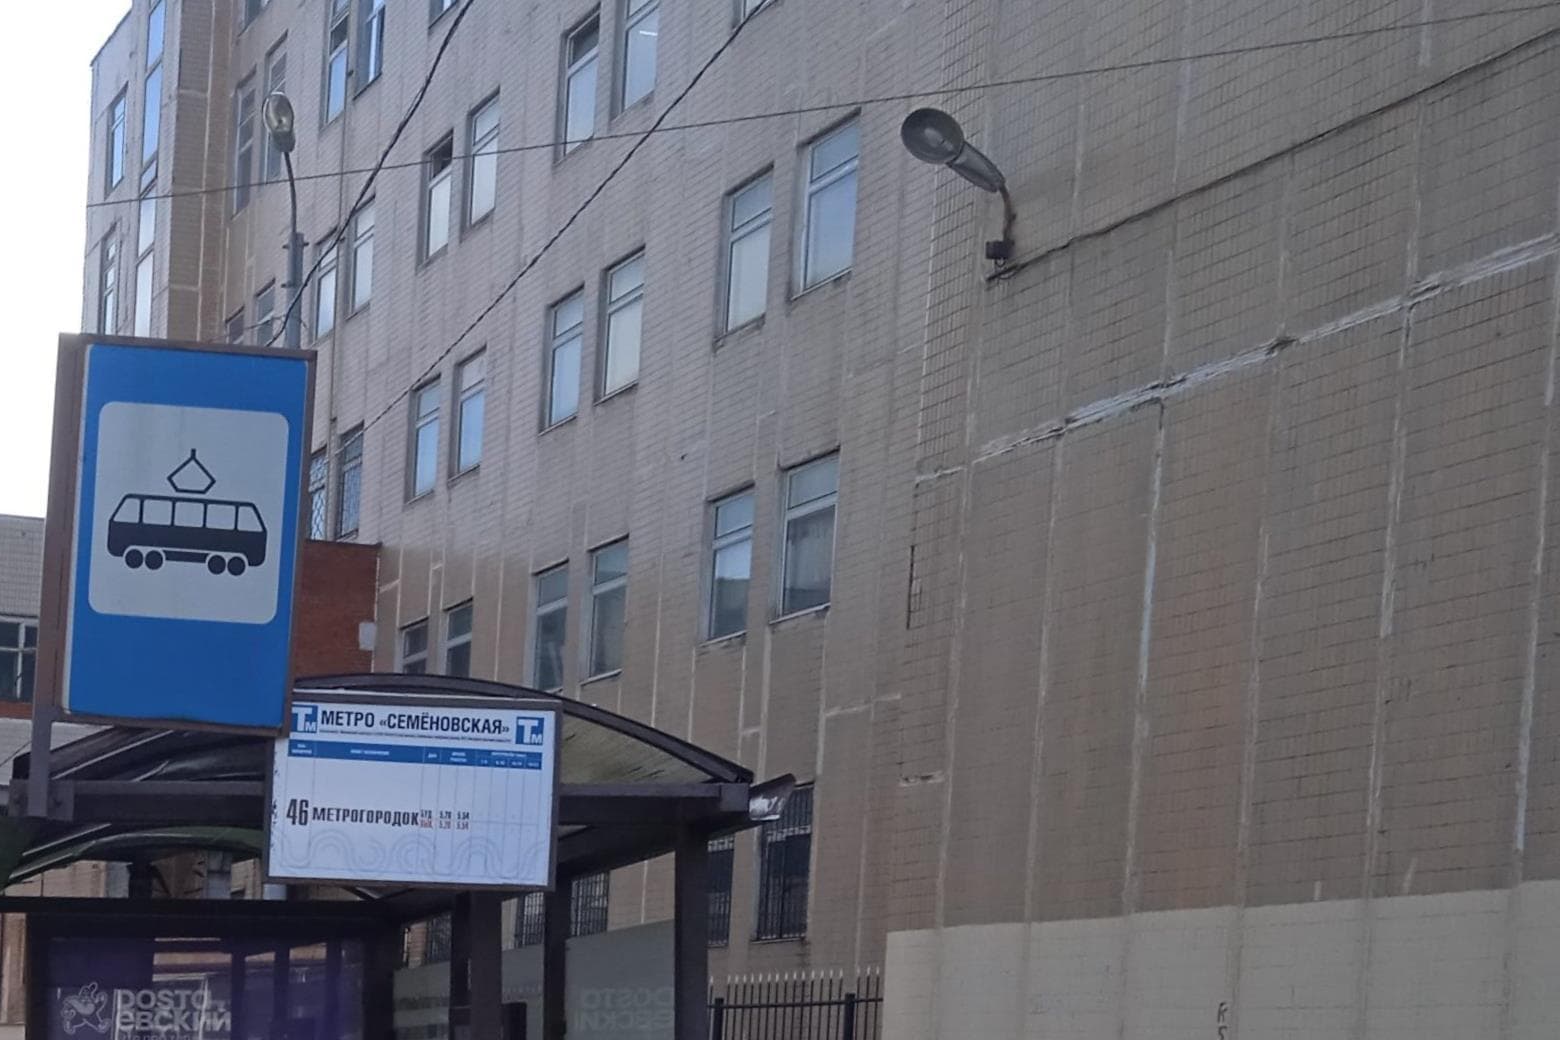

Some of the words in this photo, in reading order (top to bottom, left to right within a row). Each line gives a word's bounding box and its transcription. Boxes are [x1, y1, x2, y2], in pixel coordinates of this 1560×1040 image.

[321, 710, 375, 728] МЕТРО
[379, 711, 510, 735] «СЕМЁНОВСКАЯ»
[286, 798, 309, 826] 46
[312, 806, 419, 828] МЕТРОГОРОДОК
